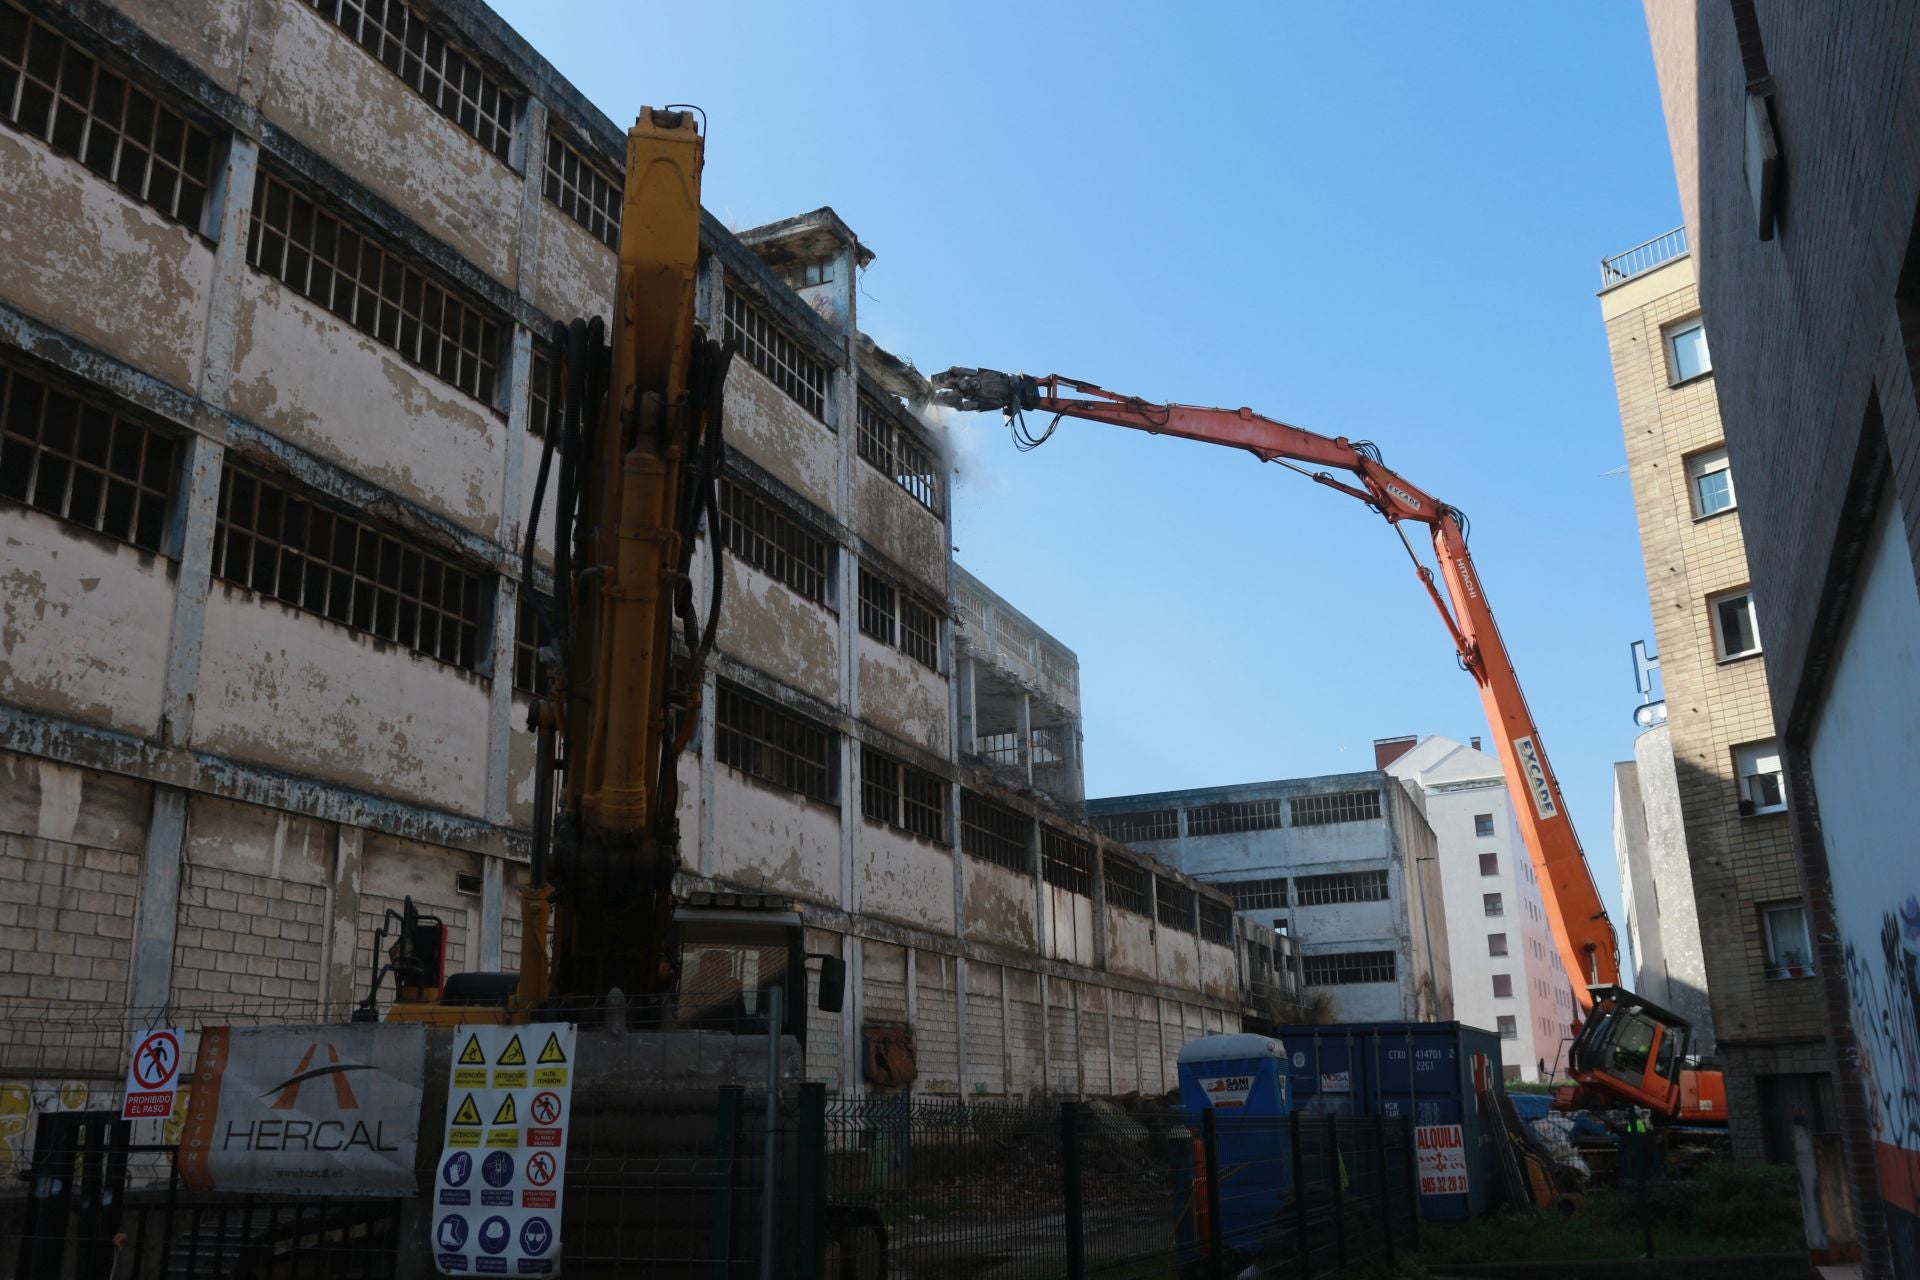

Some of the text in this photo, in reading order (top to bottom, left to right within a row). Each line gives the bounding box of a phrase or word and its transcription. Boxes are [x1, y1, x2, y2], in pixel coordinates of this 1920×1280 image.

[1389, 485, 1419, 508] EXCADE
[1457, 558, 1477, 599] HITACHI
[1519, 740, 1555, 813] EXCADE
[1415, 1049, 1441, 1059] 414701
[1448, 1048, 1455, 1059] 2
[127, 1095, 171, 1104] PROHIBIDO
[131, 1105, 164, 1114] EL PASO
[223, 1119, 398, 1152] HERCAL
[1417, 1127, 1462, 1151] ALQUILA
[1422, 1175, 1467, 1193] 985 32 28 31
